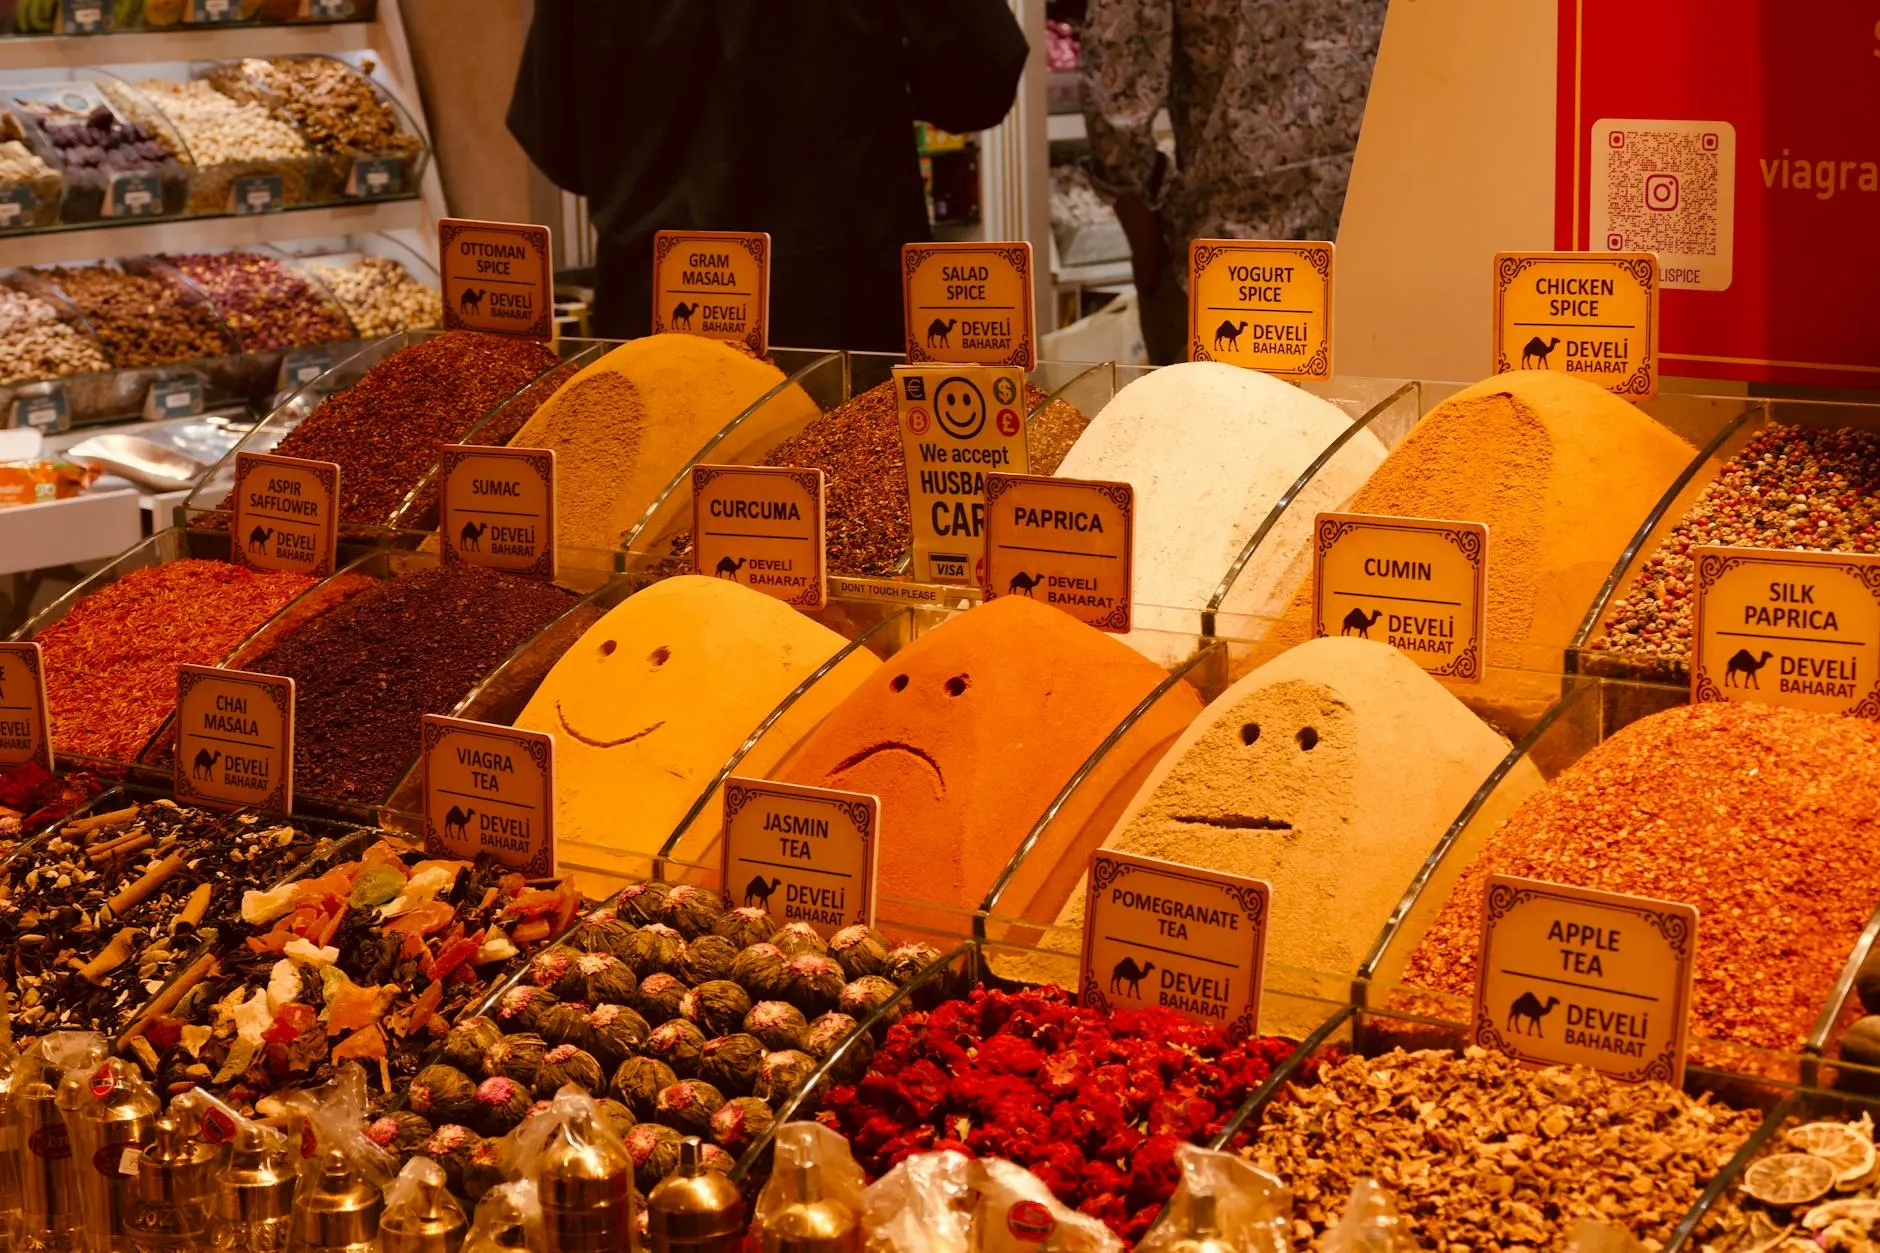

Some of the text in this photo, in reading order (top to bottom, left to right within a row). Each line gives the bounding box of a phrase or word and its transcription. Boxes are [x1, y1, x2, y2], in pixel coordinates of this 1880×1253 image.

[1759, 148, 1879, 200] viagra
[461, 242, 526, 259] OTTOMAN
[689, 253, 729, 268] GRAM
[477, 260, 511, 275] SPICE
[942, 266, 988, 281] SALAD
[1228, 266, 1294, 283] YOGURT
[1659, 268, 1701, 283] LISPICE
[682, 271, 736, 286] MASALA
[1536, 278, 1614, 296] CHICKEN
[947, 285, 986, 300] SPICE
[1239, 286, 1281, 303] SPICE
[490, 308, 533, 320] BAHARAT
[703, 303, 746, 321] DEVELİ
[1550, 300, 1599, 317] SPICE
[702, 321, 746, 333] BAHARAT
[961, 317, 1010, 336] DEVELİ
[1253, 322, 1308, 341] DEVELİ
[962, 338, 1012, 349] BAHARAT
[1253, 342, 1308, 355] BAHARAT
[1567, 338, 1628, 358] DEVELİ
[1566, 360, 1628, 373] BAHARAT
[919, 443, 1010, 468] We accept
[267, 479, 301, 496] ASPIR
[472, 479, 520, 497] SUMAC
[920, 470, 985, 496] HUSBA
[249, 493, 318, 517] SAFFLOWER
[710, 499, 800, 520] CURCUMA
[931, 501, 984, 537] CAR
[1014, 507, 1104, 534] PAPRICA
[276, 547, 315, 563] BAHARAT
[491, 543, 535, 557] BAHARAT
[937, 563, 964, 576] VISA
[1364, 558, 1431, 581] CUMIN
[749, 574, 808, 587] BAHARAT
[841, 582, 936, 600] DONT TOUCH PLEASE
[1048, 591, 1114, 609] BAHARAT
[1769, 582, 1815, 604] SILK
[1388, 615, 1453, 638] DEVELİ
[1745, 605, 1838, 631] PAPRICA
[1388, 635, 1454, 654] BAHARAT
[1780, 656, 1856, 680] DEVELİ
[1780, 678, 1857, 698] BAHARAT
[216, 695, 247, 715] CHAI
[0, 718, 30, 737] EVELİ
[204, 713, 259, 736] MASALA
[0, 739, 31, 750] AHARAT
[456, 747, 514, 773] VIAGRA
[224, 774, 269, 791] BAHARAT
[472, 771, 499, 792] TEA
[480, 814, 530, 839] DEVELİ
[763, 812, 828, 839] JASMIN
[480, 833, 531, 853] BAHARAT
[780, 837, 811, 860] TEA
[786, 883, 845, 910] DEVELİ
[785, 904, 845, 927] BAHARAT
[1112, 888, 1239, 931] POMEGRANATE
[1157, 918, 1188, 941] TEA
[1548, 920, 1621, 952] APPLE
[1560, 949, 1603, 978] TEA
[1160, 968, 1230, 1002] DEVELİ
[1159, 991, 1228, 1020] BAHARAT
[1566, 1003, 1648, 1039] DEVELİ
[1564, 1028, 1647, 1058] BAHARAT
